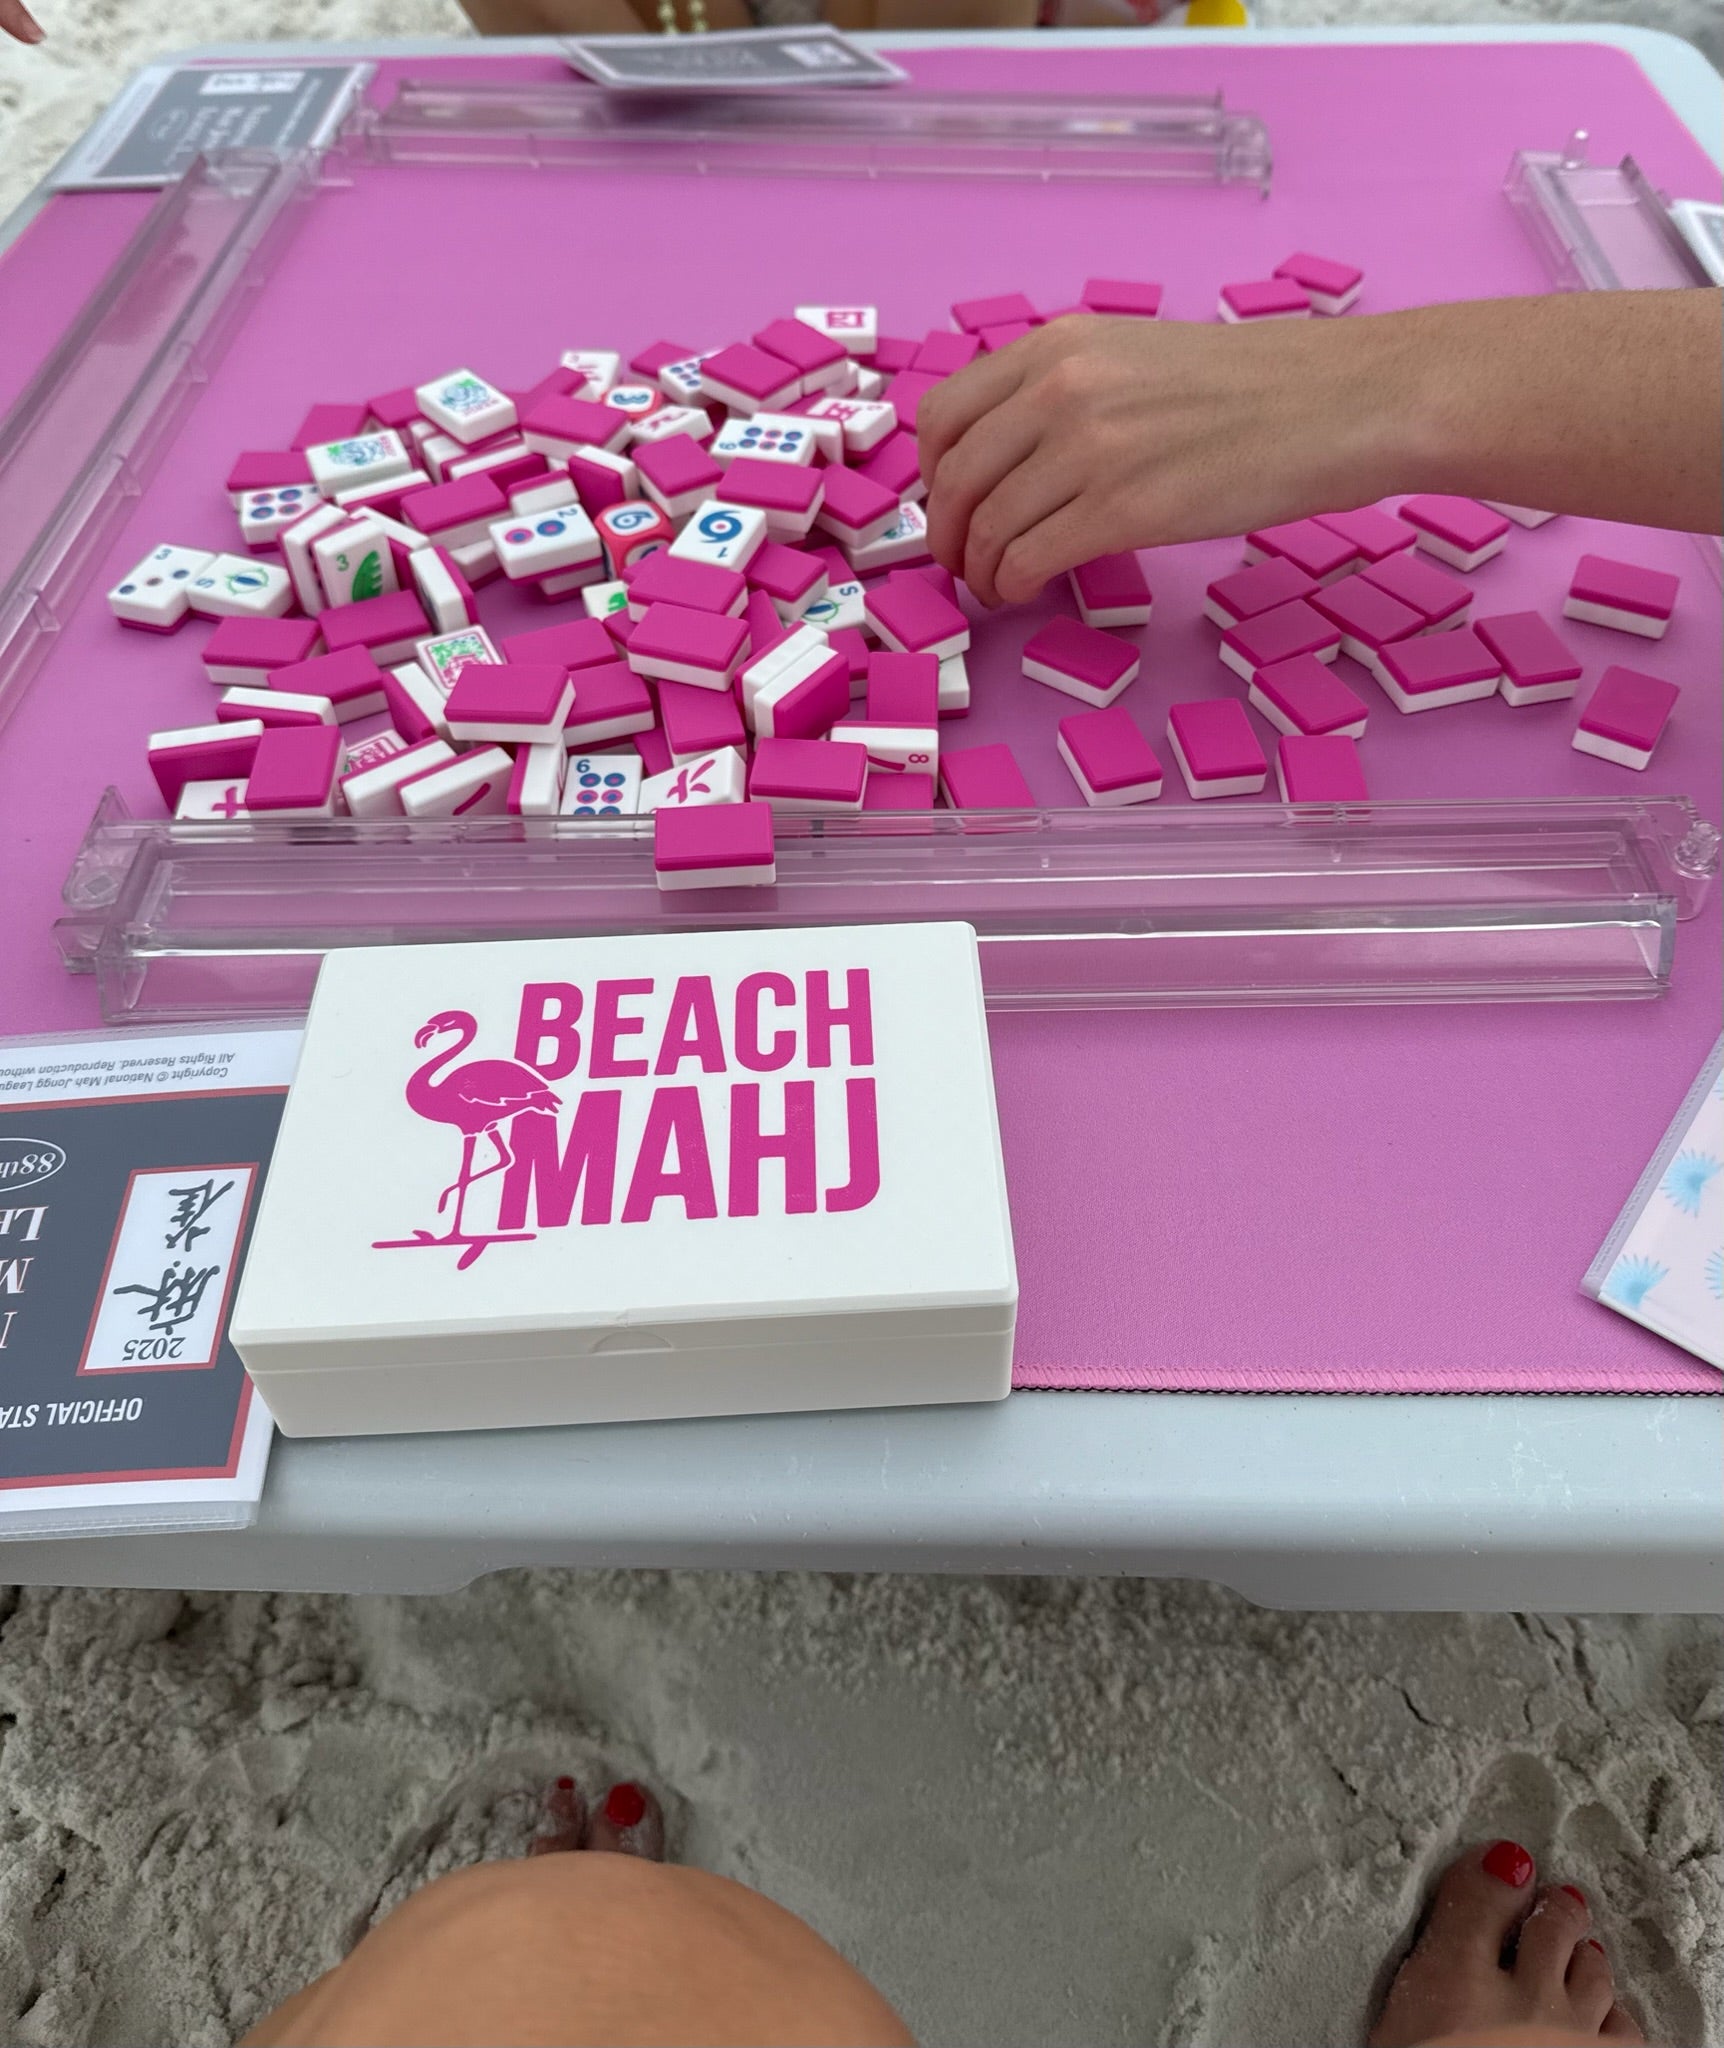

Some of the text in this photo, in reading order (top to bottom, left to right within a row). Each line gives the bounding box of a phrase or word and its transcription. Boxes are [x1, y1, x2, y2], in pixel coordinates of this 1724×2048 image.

[557, 508, 578, 519] 2
[155, 548, 172, 561] 3
[717, 547, 728, 559] 1
[336, 554, 350, 572] 3
[908, 753, 930, 764] 8
[576, 759, 591, 774] 6
[514, 968, 875, 1081] BEACH
[120, 1056, 176, 1070] Reserved.
[179, 1052, 216, 1064] Rights
[218, 1052, 236, 1063] All
[38, 1060, 116, 1074] Reproduction
[171, 1066, 229, 1081] Copyright
[36, 1078, 73, 1089] Jongg
[76, 1076, 102, 1087] Mah
[103, 1072, 154, 1086] National
[497, 1077, 881, 1231] MAHJ
[122, 1337, 186, 1361] 2025
[46, 1397, 143, 1426] OFFICIAL
